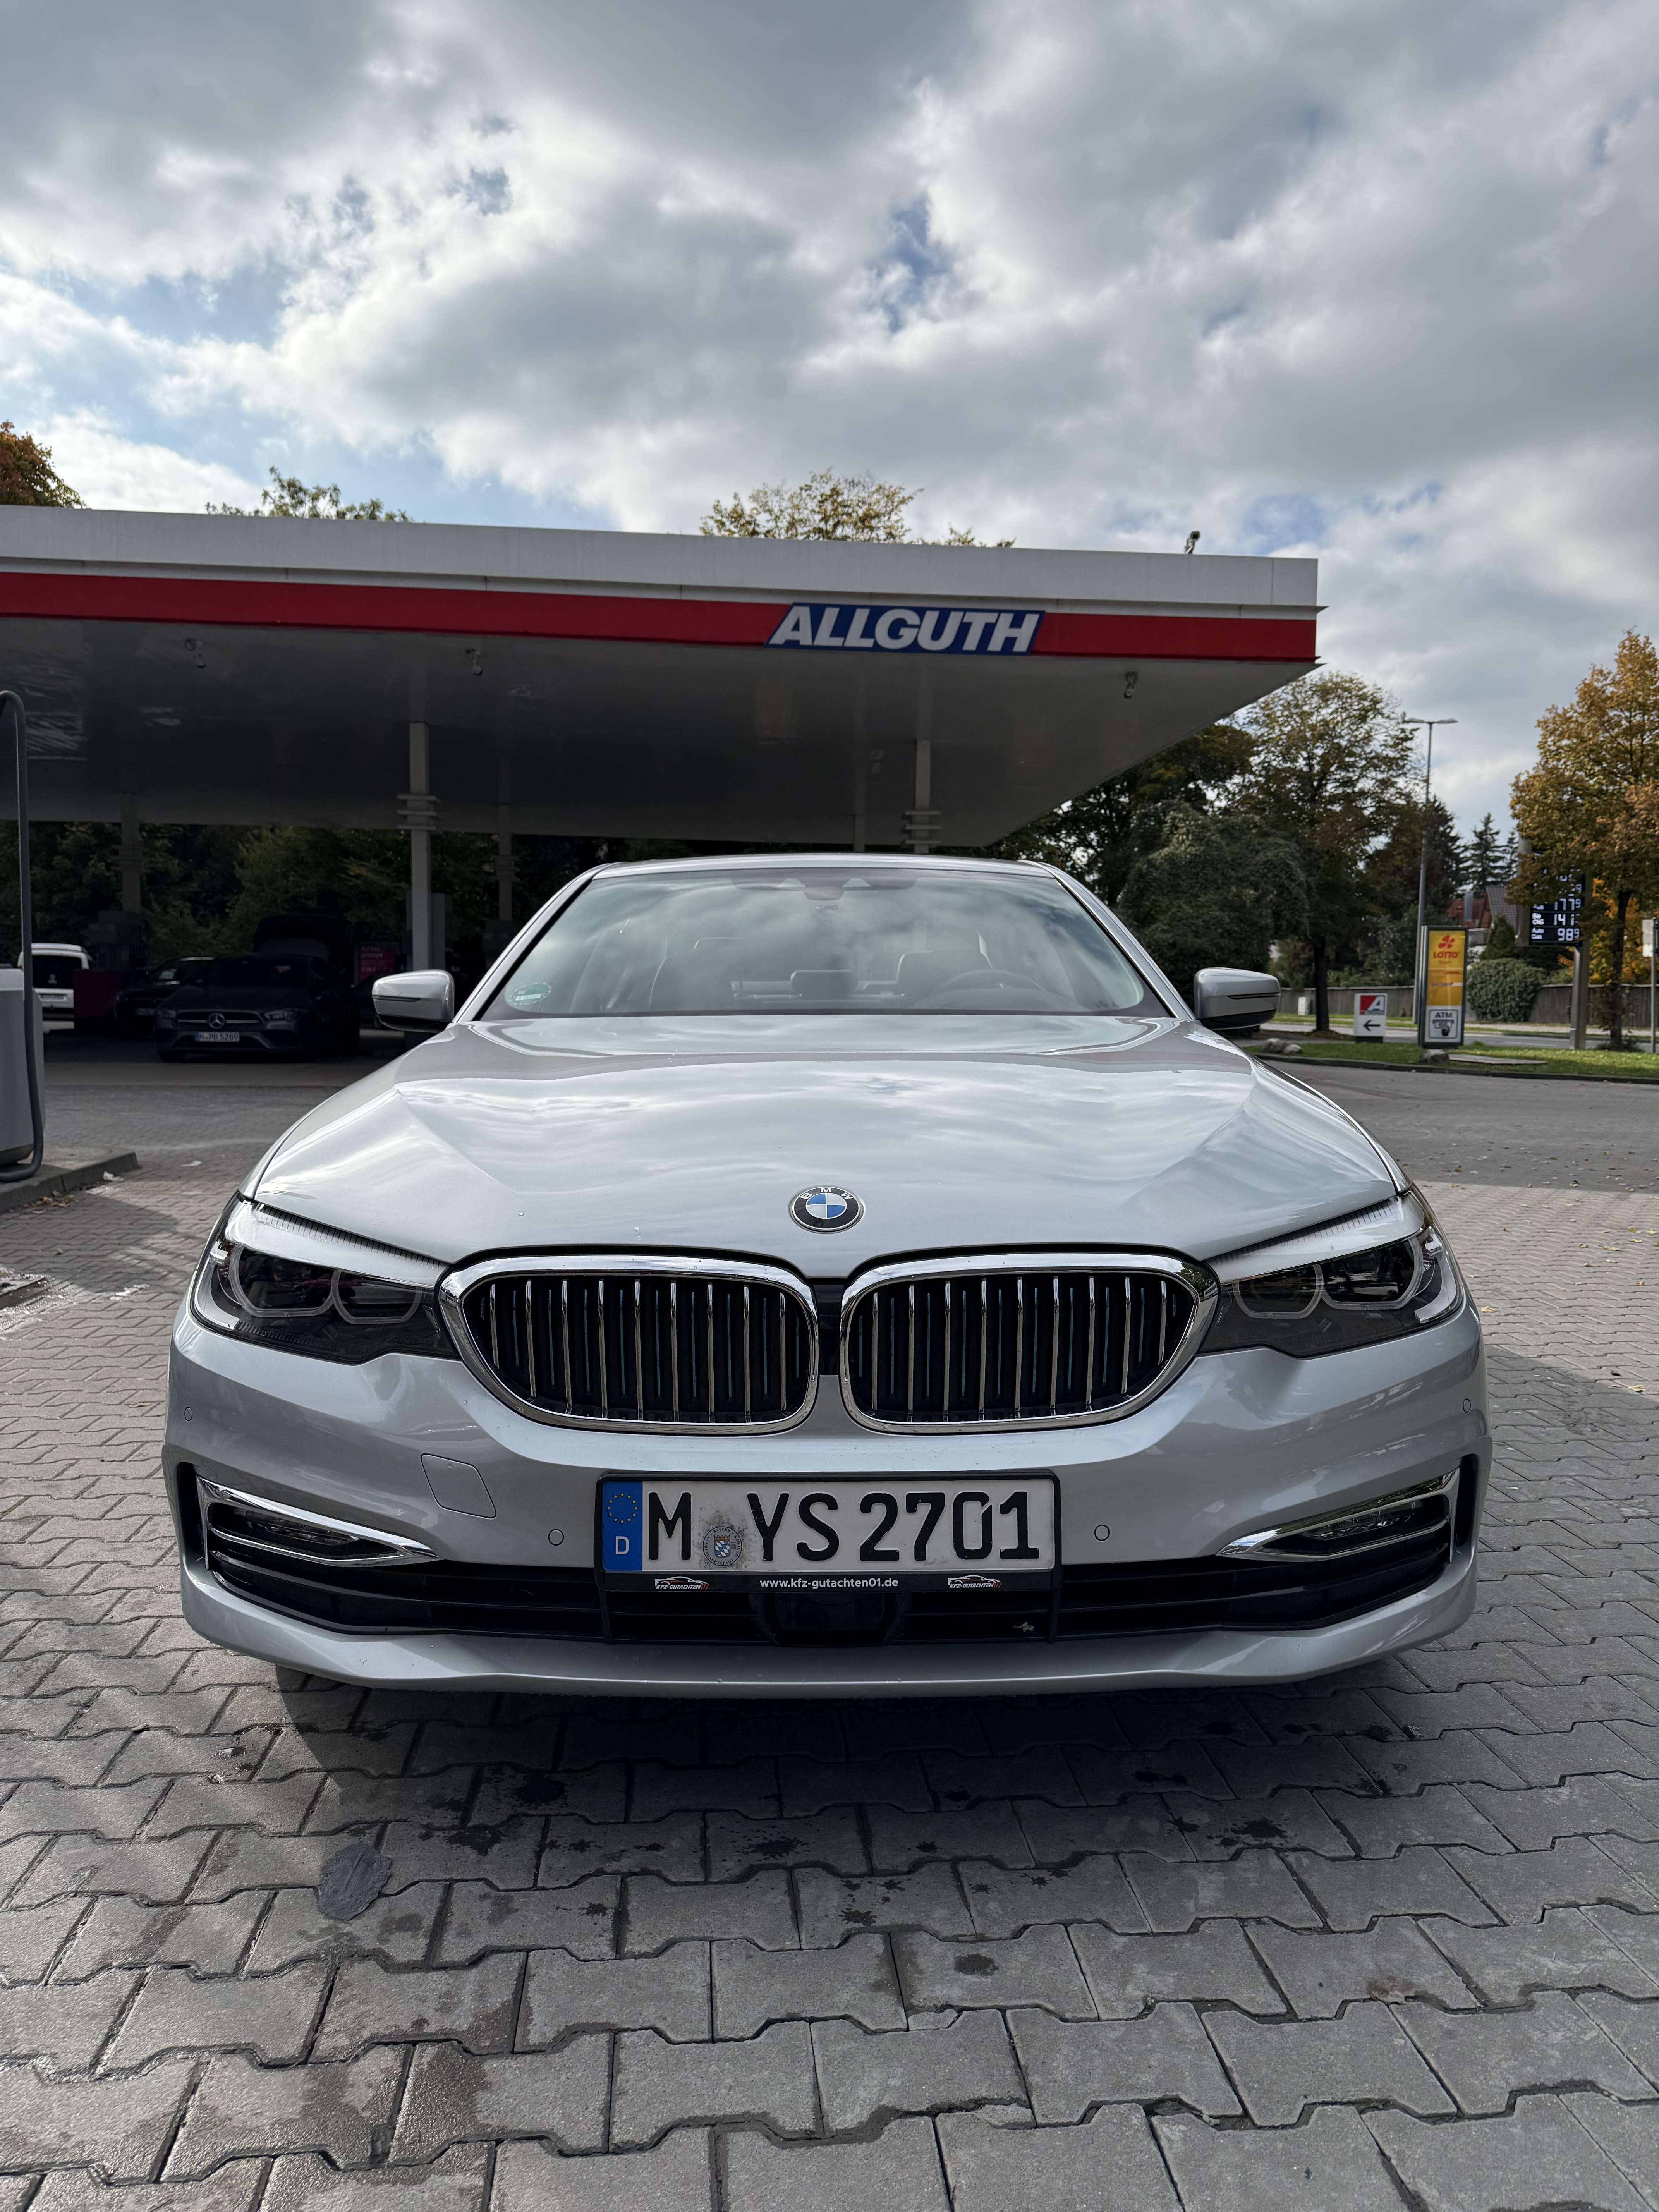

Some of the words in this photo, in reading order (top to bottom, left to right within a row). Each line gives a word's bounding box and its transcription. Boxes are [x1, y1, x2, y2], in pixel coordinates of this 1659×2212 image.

[768, 606, 1040, 652] ALLGUTH
[800, 1188, 854, 1199] BMW
[648, 1492, 691, 1560] M
[615, 1536, 629, 1554] D
[760, 1578, 899, 1589] www.kfz-gutachten01.de
